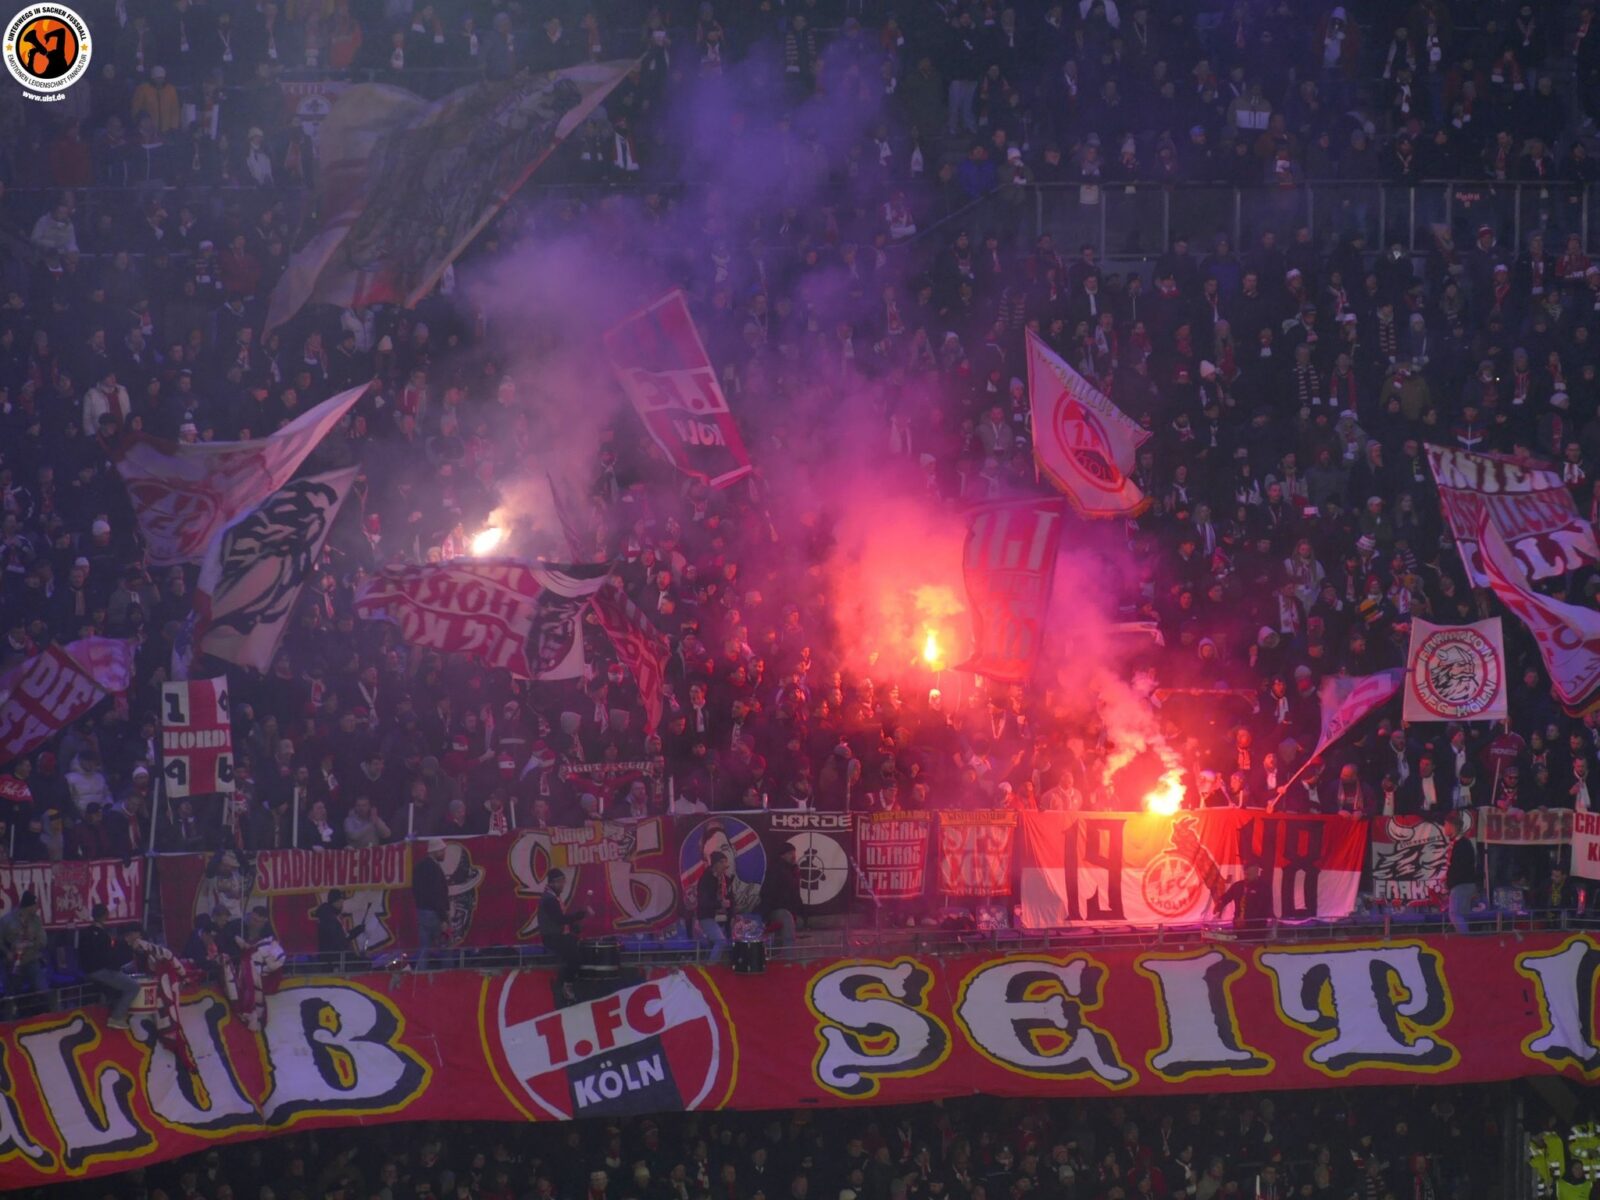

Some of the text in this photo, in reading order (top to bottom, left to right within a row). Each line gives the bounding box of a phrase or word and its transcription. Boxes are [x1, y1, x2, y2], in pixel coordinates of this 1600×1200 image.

[1455, 679, 1497, 719] KÖLN
[771, 813, 852, 829] HORDE
[257, 844, 408, 892] STADIONVERBOT
[866, 847, 921, 865] ULTRAS
[1062, 816, 1326, 921] 19 48
[535, 984, 666, 1066] 1.FC
[812, 946, 1452, 1092] SEIT
[573, 1053, 666, 1109] KÖLN
